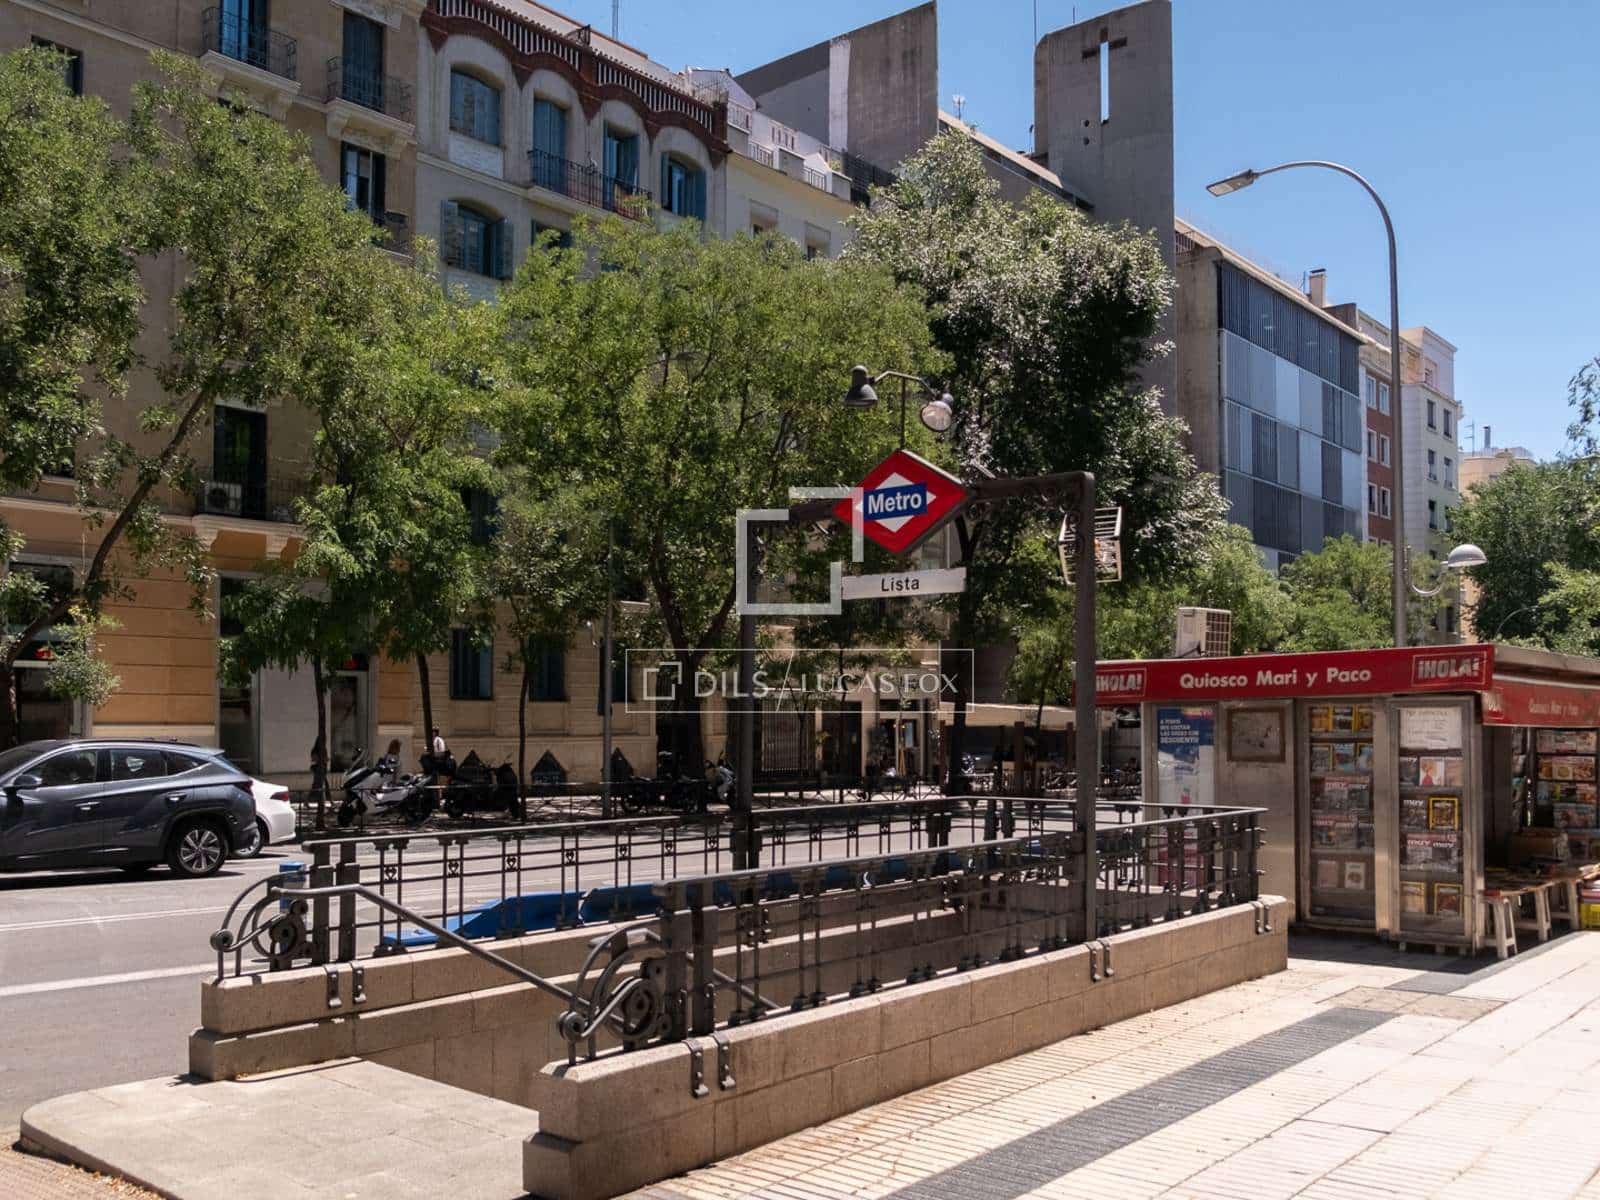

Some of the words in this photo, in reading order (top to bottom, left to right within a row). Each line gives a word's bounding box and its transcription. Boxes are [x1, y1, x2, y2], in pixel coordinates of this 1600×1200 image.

[868, 492, 922, 515] Metro
[881, 577, 920, 592] Lista
[1179, 673, 1248, 689] Quiosco
[1256, 669, 1297, 685] Mari
[1306, 672, 1318, 688] y
[1327, 667, 1371, 683] Paco
[1418, 658, 1480, 679] ¡HOLA!
